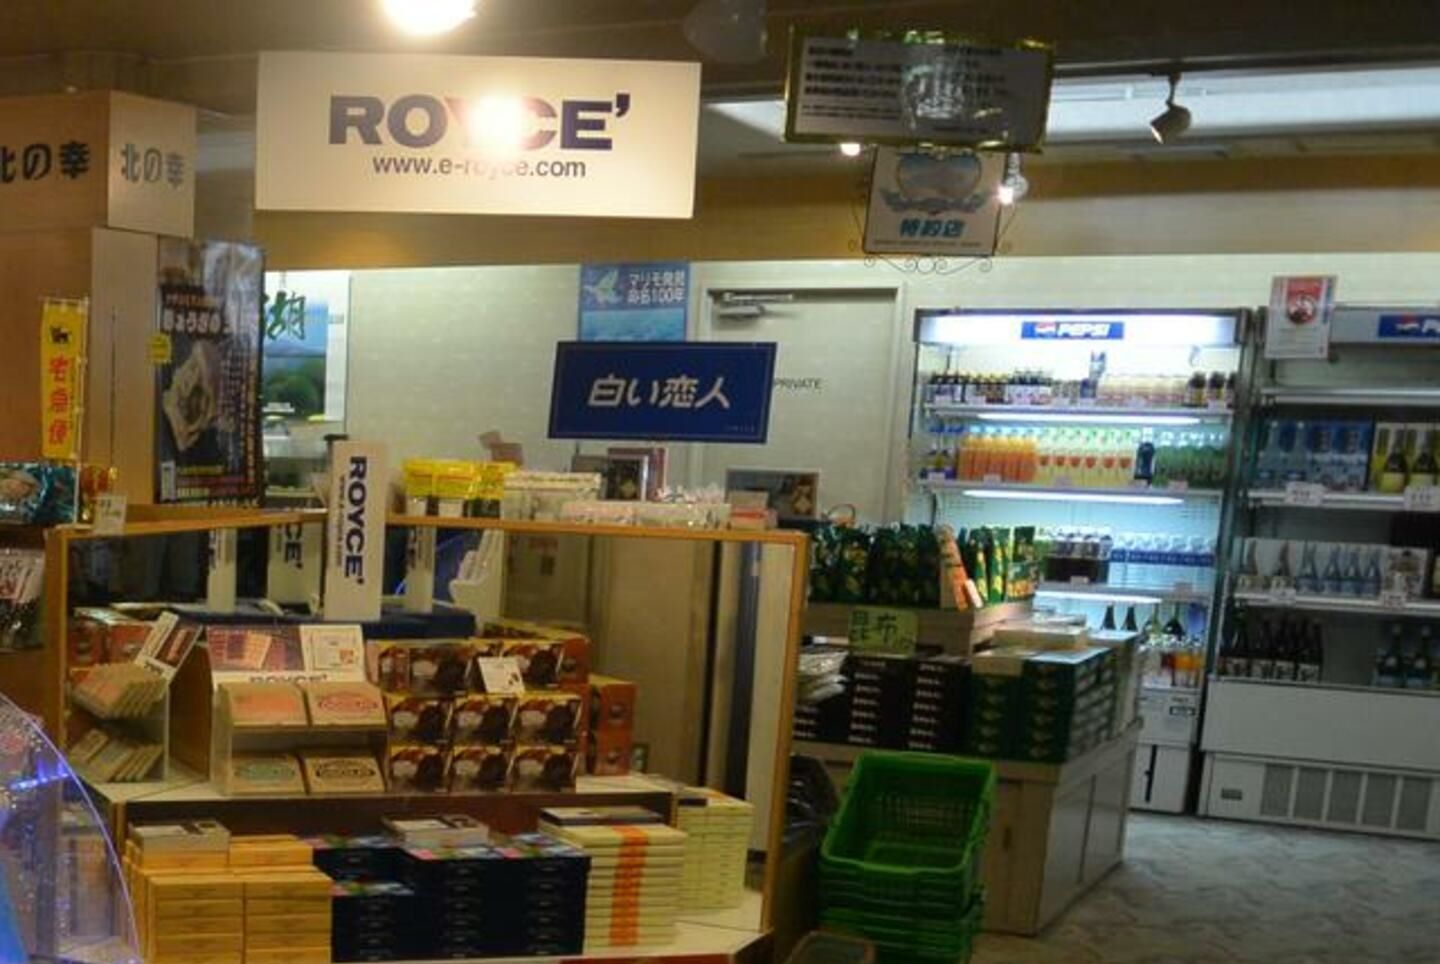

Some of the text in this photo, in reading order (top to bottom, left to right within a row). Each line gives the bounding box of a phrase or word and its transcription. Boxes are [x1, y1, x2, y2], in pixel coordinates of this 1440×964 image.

[328, 92, 631, 151] ROCE'
[121, 143, 185, 189] 北の幸
[372, 155, 586, 179] www.e-royce.com
[587, 374, 731, 409] 白い恋人
[774, 378, 821, 390] PRIVATE
[345, 456, 368, 586] ROYCE'
